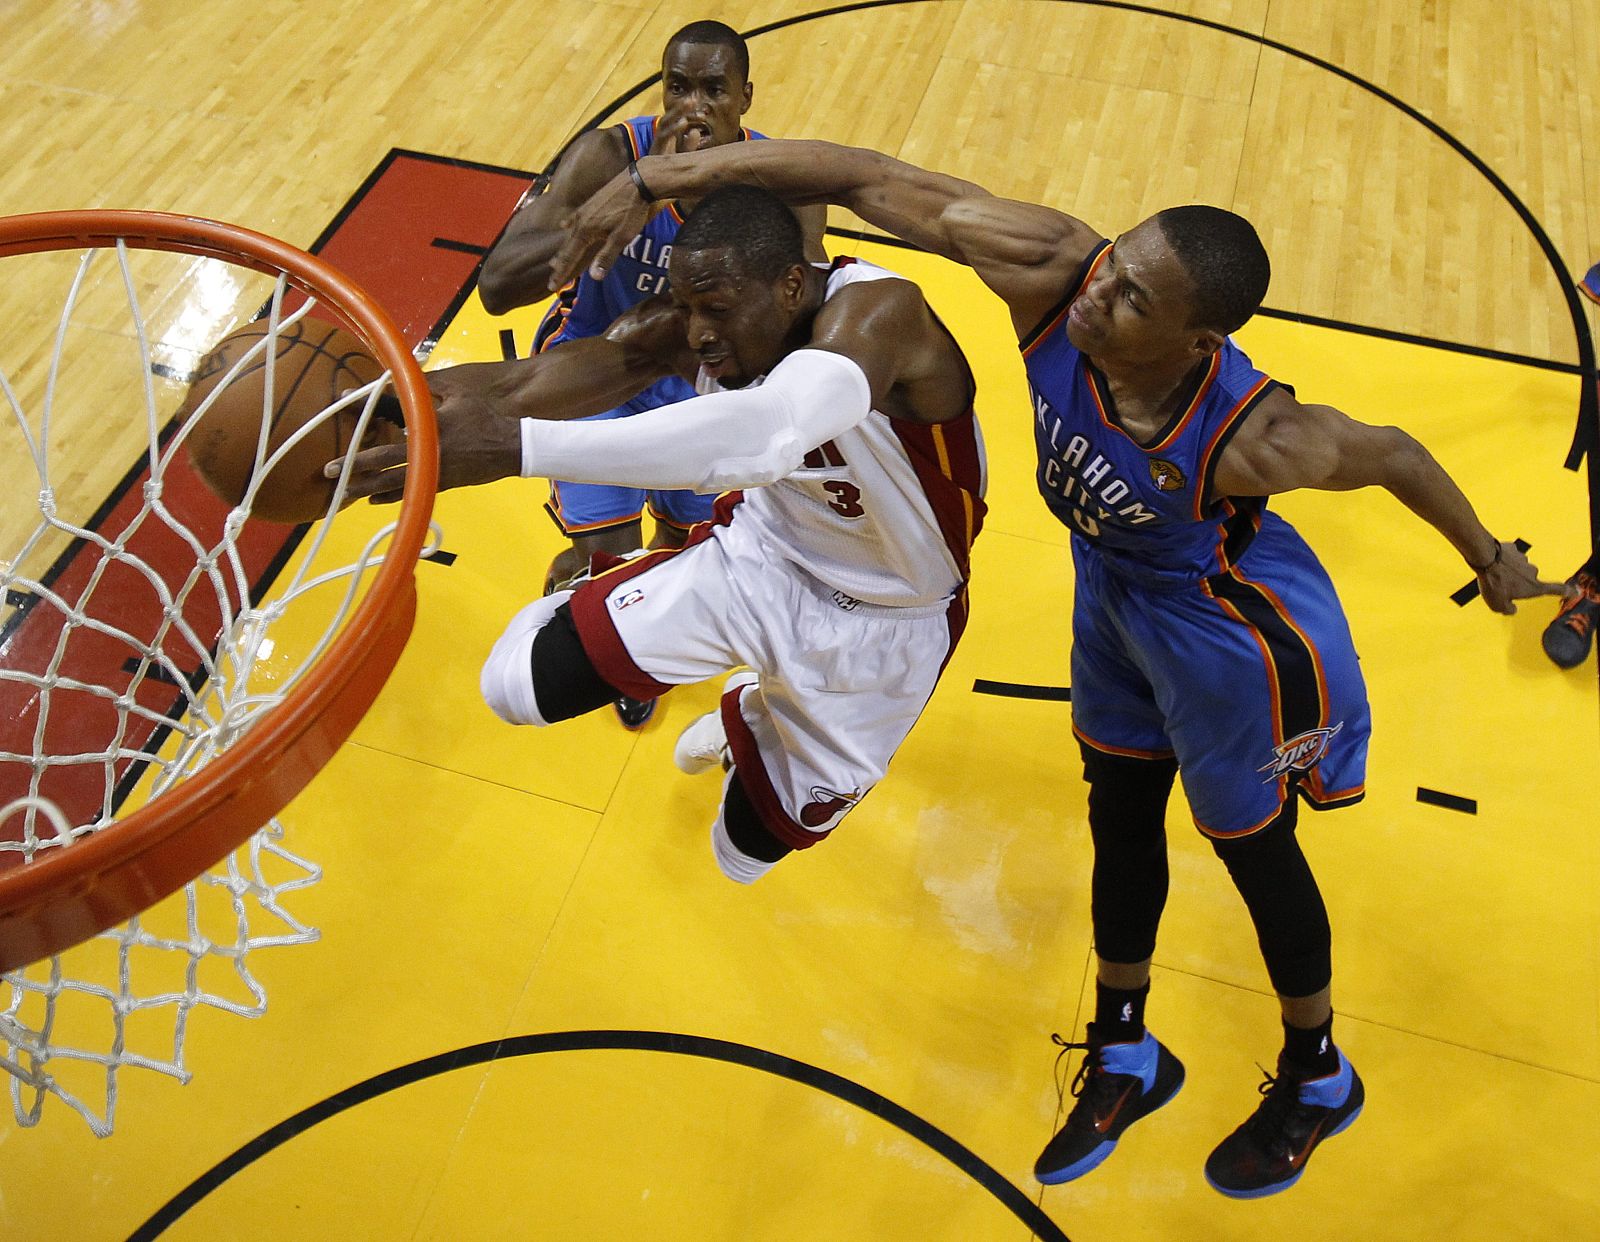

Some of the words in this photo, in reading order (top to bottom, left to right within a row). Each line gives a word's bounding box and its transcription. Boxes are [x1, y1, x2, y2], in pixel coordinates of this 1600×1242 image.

[622, 234, 674, 270] KLA
[636, 273, 666, 295] CI
[1030, 383, 1157, 525] KLAHOM
[821, 479, 865, 519] 3
